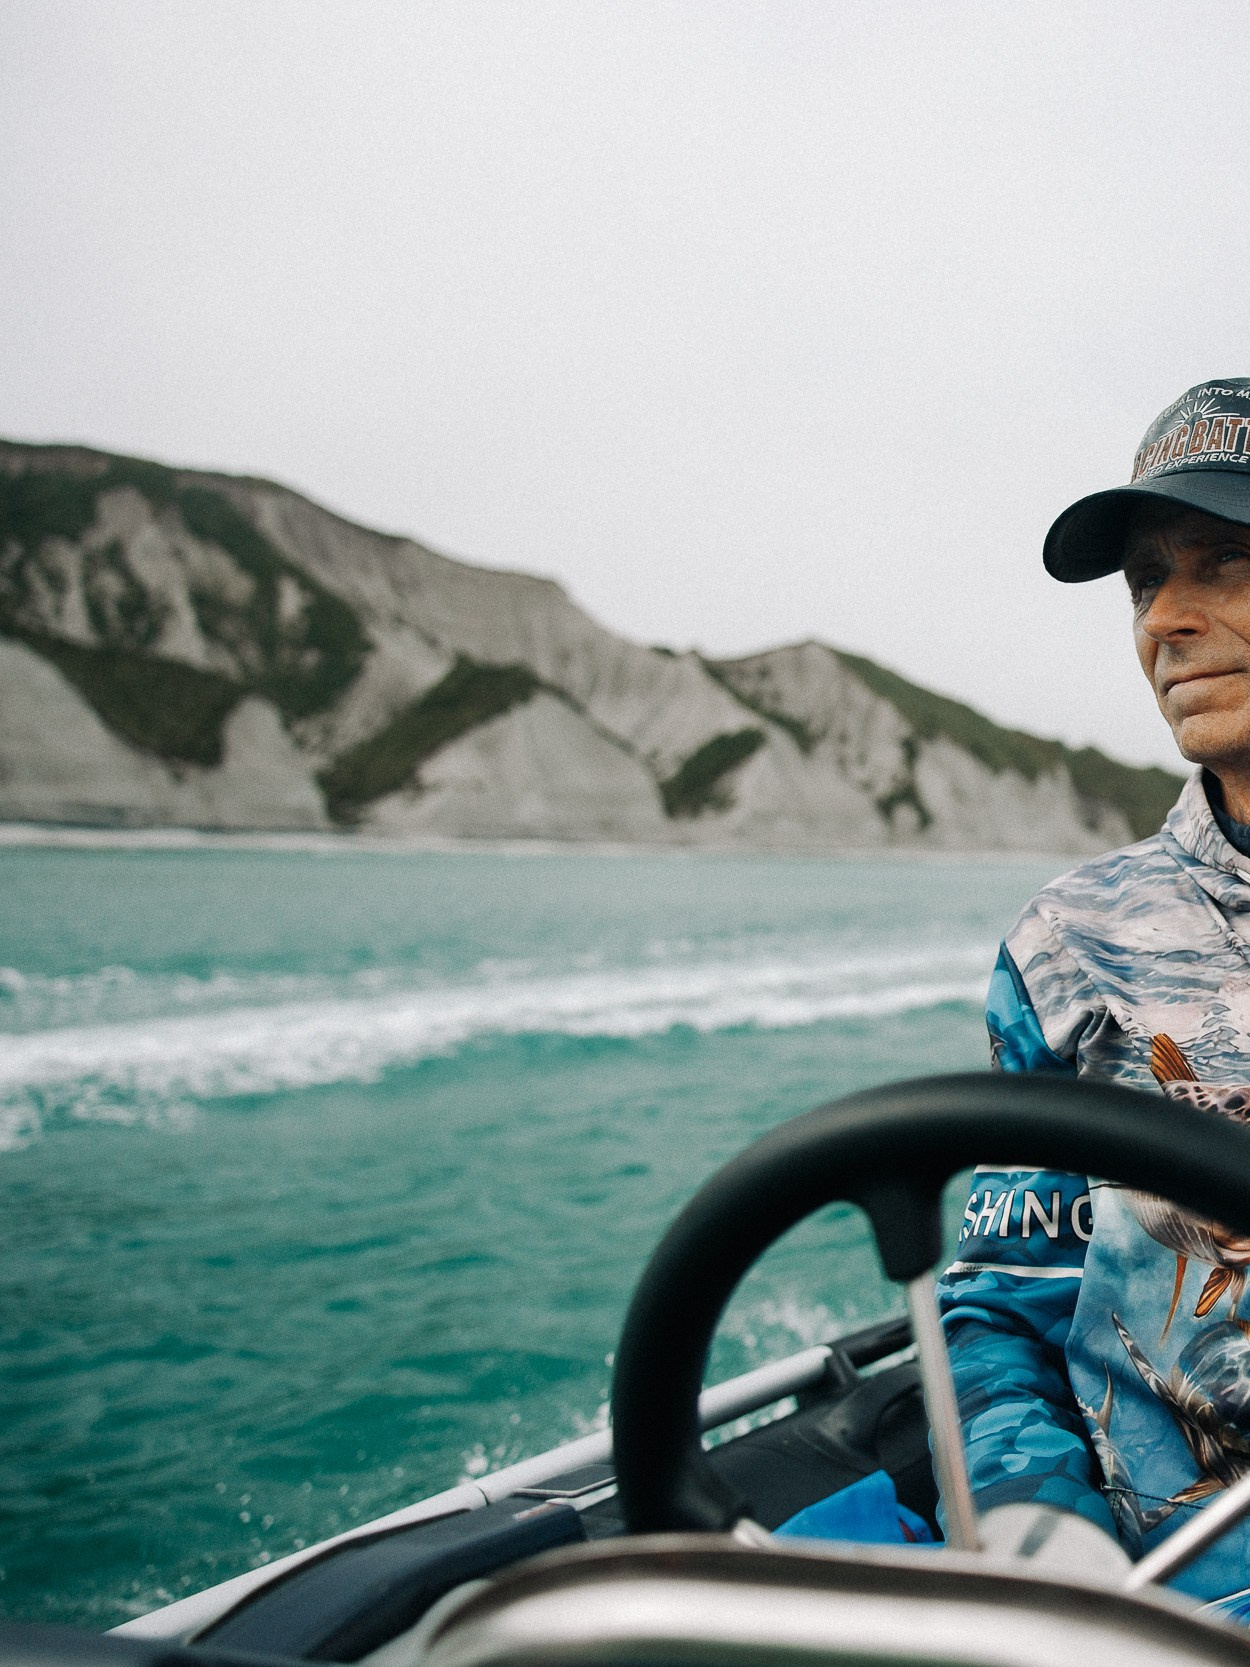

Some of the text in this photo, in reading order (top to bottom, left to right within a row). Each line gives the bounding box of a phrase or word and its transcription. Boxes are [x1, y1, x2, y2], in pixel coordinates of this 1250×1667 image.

[1198, 387, 1234, 399] INTO
[1164, 452, 1250, 472] EXPERIENCE
[958, 1189, 1093, 1243] SHING
